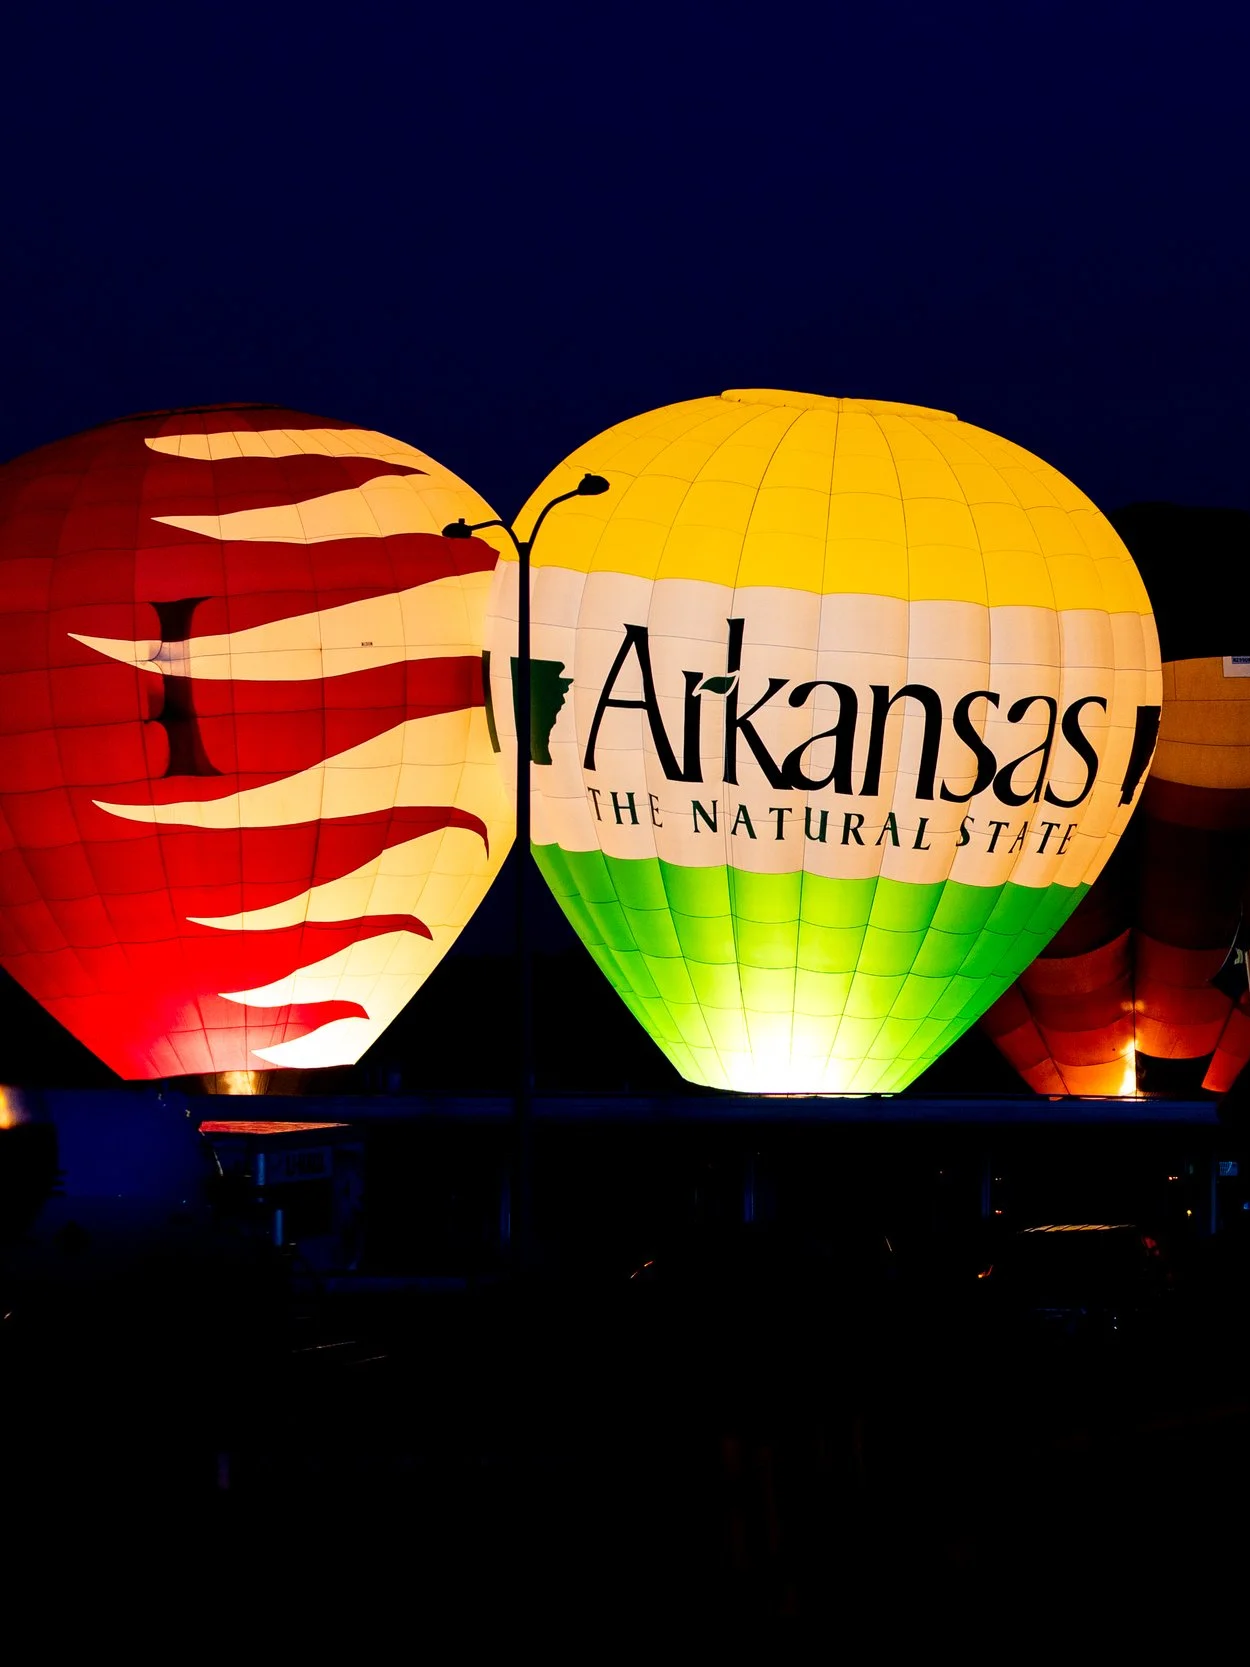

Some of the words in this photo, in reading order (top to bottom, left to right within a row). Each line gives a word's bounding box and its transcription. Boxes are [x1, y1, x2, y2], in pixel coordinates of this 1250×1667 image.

[583, 618, 1108, 809] Arkansas
[586, 786, 664, 829] THE
[691, 798, 933, 852] NATURAL
[955, 814, 1078, 857] STATE
